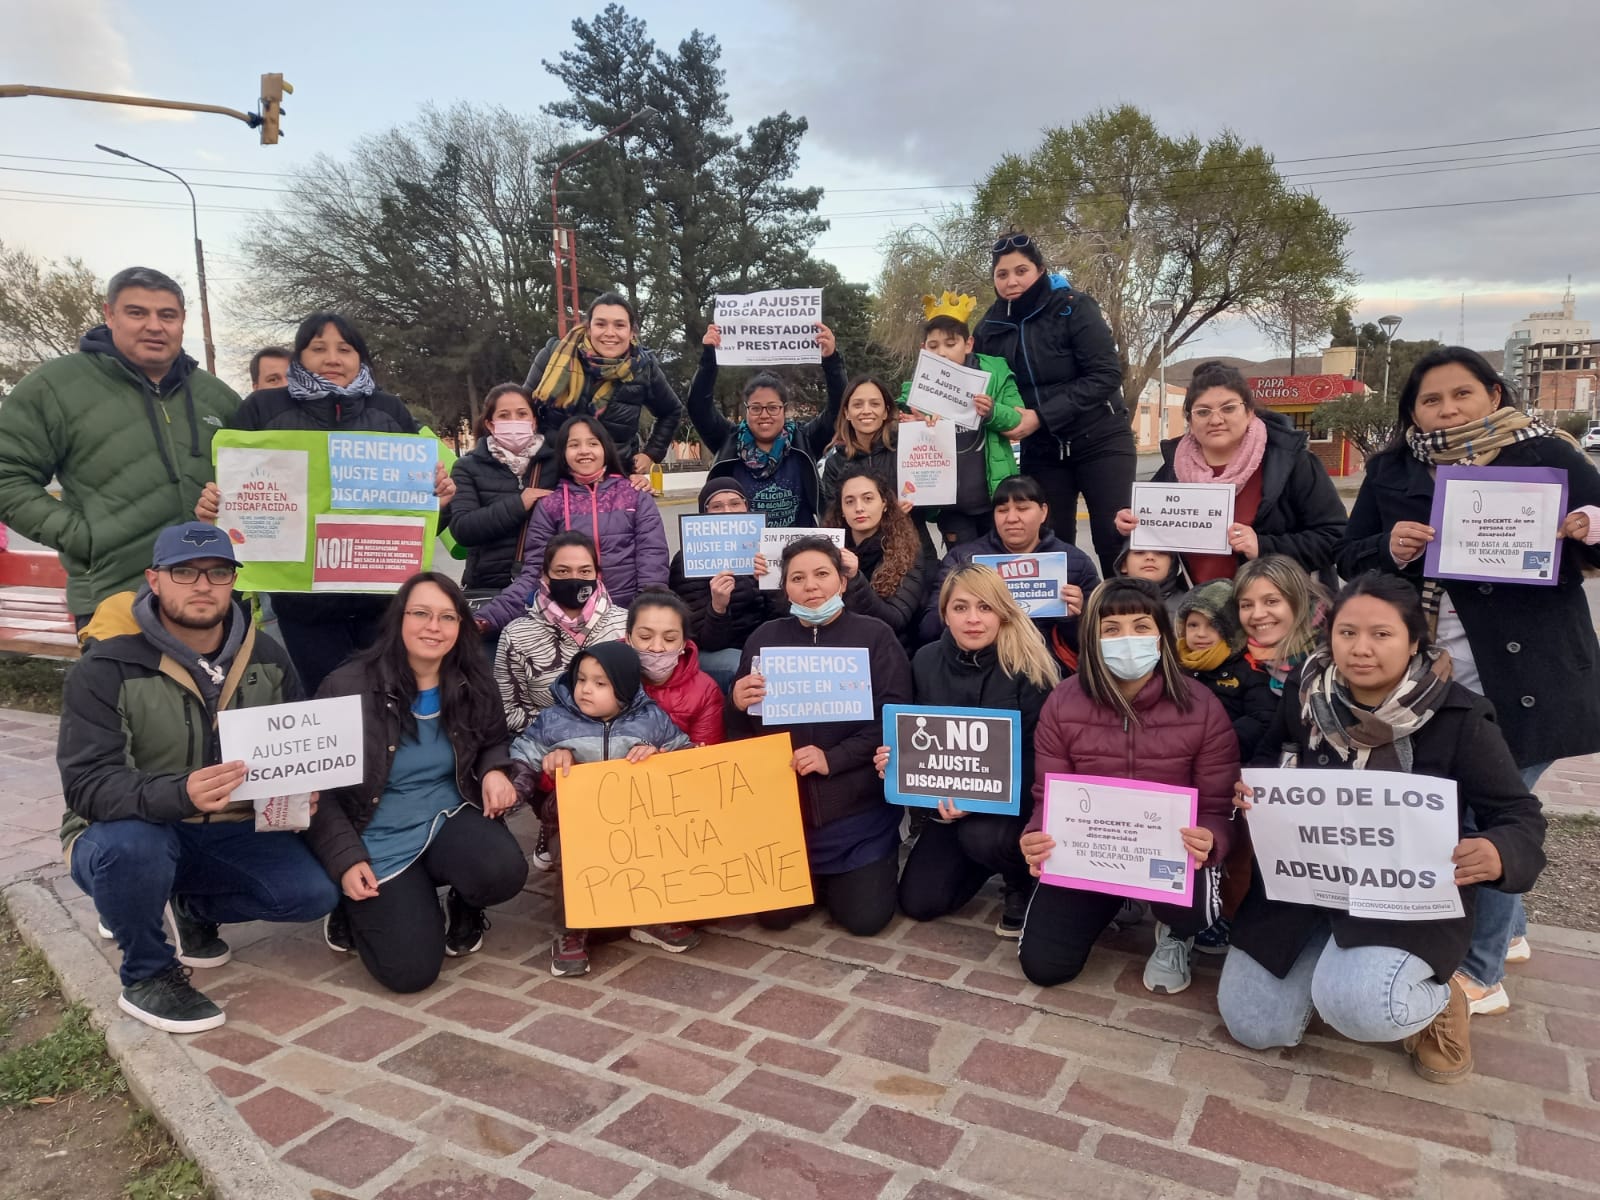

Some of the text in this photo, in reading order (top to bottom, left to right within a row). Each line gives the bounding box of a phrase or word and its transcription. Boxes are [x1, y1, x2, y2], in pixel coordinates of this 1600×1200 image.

[716, 300, 738, 308] NO
[758, 295, 820, 307] AJUSTE
[720, 308, 816, 317] DISCAPACIDAD
[741, 325, 819, 335] PRESTADOR
[737, 338, 819, 350] PRESTACIÓN
[941, 369, 950, 378] NO
[920, 372, 976, 400] AL AJUSTE EN
[1258, 378, 1284, 388] PAPA
[918, 382, 968, 408] DISCAPACIDAD
[1252, 387, 1299, 398] NCHO'S
[331, 439, 428, 463] FRENEMOS
[910, 452, 944, 460] AJUSTE EN
[902, 460, 950, 468] DISCAPACIDAD
[332, 465, 400, 482] AJUSTE EN
[268, 482, 279, 490] AL
[237, 492, 287, 502] AJUSTE EN
[225, 502, 298, 512] DISCAPACIDAD
[1160, 508, 1200, 516] AJUSTE
[685, 520, 756, 536] FRENEMOS
[1140, 519, 1212, 528] DISCAPACIDAD
[764, 534, 778, 542] SIN
[316, 538, 353, 568] NO!!
[686, 540, 737, 556] AJUSTE EN
[1001, 561, 1035, 578] NO
[1008, 582, 1030, 590] uste
[1012, 590, 1055, 600] pacidad
[766, 656, 858, 674] FRENEMOS
[766, 680, 832, 698] AJUSTE EN
[766, 701, 861, 718] DISCAPACIDAD
[267, 712, 320, 732] NO AL
[946, 720, 989, 752] NO
[252, 734, 337, 760] AJUSTE EN
[244, 754, 356, 782] ISCAPACIDAD
[928, 754, 980, 773] AJUSTE
[906, 773, 1002, 793] DISCAPACIDAD
[598, 760, 754, 825] CALETA
[1252, 786, 1445, 811] PAGO DE LOS
[1094, 819, 1132, 827] DOCENTE
[1086, 833, 1137, 842] discapacidad
[1298, 825, 1395, 847] MESES
[1062, 840, 1068, 848] Y
[1072, 841, 1090, 849] DIGO
[1092, 843, 1117, 852] BASTA
[1134, 847, 1164, 856] AJUSTE
[1090, 851, 1145, 862] DISCAPACIDAD
[576, 841, 808, 916] PRESENTE
[1275, 859, 1436, 889] ADEUDADOS
